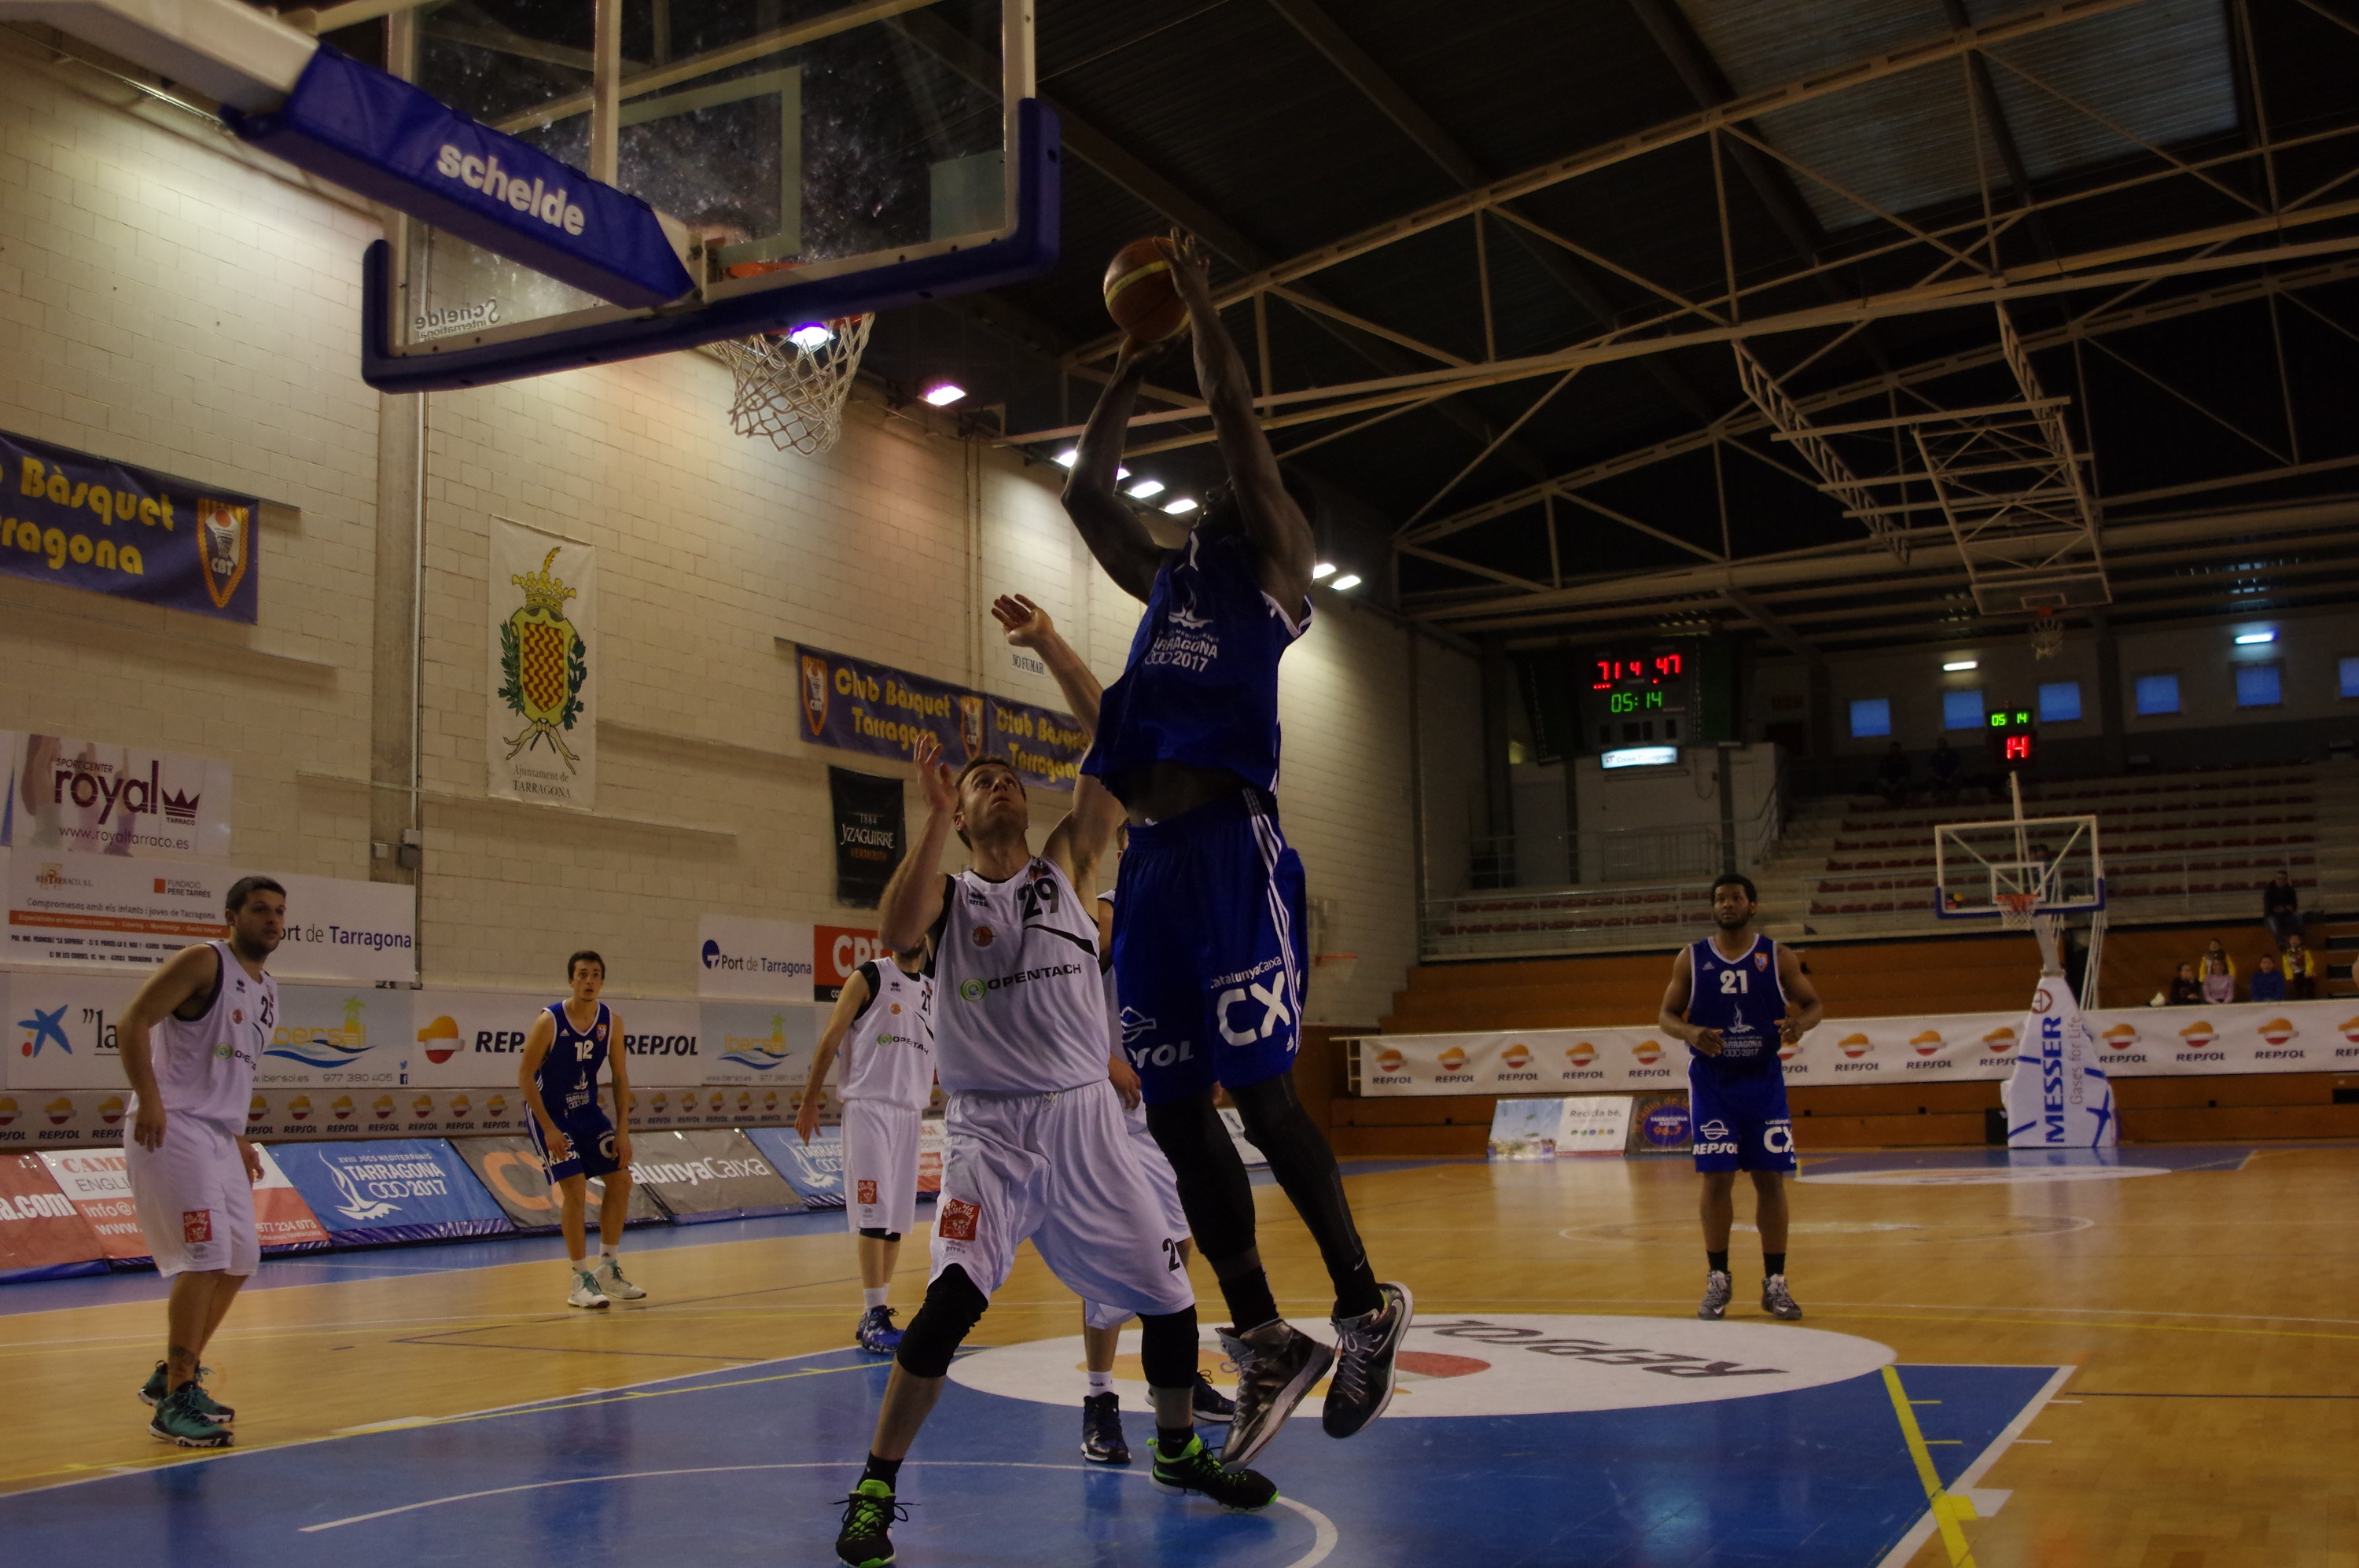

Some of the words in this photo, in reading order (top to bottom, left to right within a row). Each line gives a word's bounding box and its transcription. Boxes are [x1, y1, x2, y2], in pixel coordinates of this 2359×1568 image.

[436, 144, 585, 236] schelde
[20, 456, 174, 532] Bàsquet
[0, 516, 144, 575] ragona
[1172, 650, 1209, 672] 2017
[1595, 659, 1623, 681] 71
[1628, 659, 1643, 677] 4
[1654, 653, 1682, 675] 47
[835, 668, 880, 702] Club
[1610, 691, 1664, 713] 05:14
[996, 707, 1033, 738] Club
[1990, 712, 2008, 727] 05
[2015, 711, 2030, 724] 14
[2005, 734, 2031, 760] 14
[56, 757, 82, 769] SPORT
[84, 761, 113, 773] CENTER
[513, 764, 558, 780] Ajuntament
[559, 771, 569, 783] de
[55, 760, 159, 825] royal
[513, 780, 572, 799] TARRAGONA
[167, 817, 196, 826] TARRACO
[59, 827, 190, 850] www.royaltarraco.es
[840, 823, 894, 849] YZAGUIRRE
[850, 848, 887, 862] VERMOUTH
[167, 888, 185, 896] PERE
[1017, 878, 1059, 922] 29
[28, 898, 84, 910] Compromesos
[86, 904, 103, 912] amb
[181, 910, 215, 920] Tarragona
[306, 923, 324, 943] de
[329, 926, 411, 951] Tarragona
[721, 955, 743, 971] Port
[747, 955, 759, 971] de
[761, 957, 811, 977] Tarragona
[988, 963, 1082, 991] OPENTACH
[1720, 970, 1749, 994] 21
[1216, 970, 1291, 1047] CX
[2066, 1016, 2081, 1040] Life
[475, 1031, 525, 1053] REP
[574, 1040, 594, 1062] 12
[624, 1035, 698, 1057] REPSOL
[1723, 1040, 1763, 1049] ARRAGONA
[2070, 1043, 2082, 1062] for
[1372, 1076, 1412, 1084] REPSOL
[1435, 1074, 1474, 1084] REPSOL
[1498, 1073, 1538, 1081] REPSOL
[1562, 1070, 1604, 1080] REPSOL
[1628, 1069, 1671, 1078] REPSOL
[1782, 1065, 1809, 1073] PSOL
[1835, 1062, 1880, 1072] REPSOL
[1906, 1060, 1952, 1069] REPSOL
[1979, 1058, 2019, 1067] REPSO
[2100, 1055, 2147, 1063] REPSOL
[2177, 1052, 2226, 1062] REPSOL
[2254, 1050, 2306, 1059] REPSOL
[2335, 1048, 2359, 1057] REP
[2042, 1016, 2065, 1143] MESSER
[2070, 1067, 2083, 1105] Gases
[0, 1131, 26, 1141] PSOL
[39, 1130, 80, 1139] REPSOL
[92, 1129, 123, 1139] REPS
[246, 1126, 273, 1135] EPSOL
[284, 1125, 317, 1134] REPSOL
[368, 1123, 399, 1132] REPSOL
[408, 1122, 437, 1131] REPSOL
[446, 1121, 474, 1130] REPSOL
[343, 1162, 446, 1181] TARRAGONA
[627, 1157, 771, 1187] alunyaCaixa
[75, 1177, 131, 1192] ENGLI
[406, 1179, 447, 1196] 2017
[0, 1193, 78, 1220] a.com
[82, 1202, 137, 1217] info@
[95, 1222, 142, 1235] www.
[275, 1220, 296, 1231] 234
